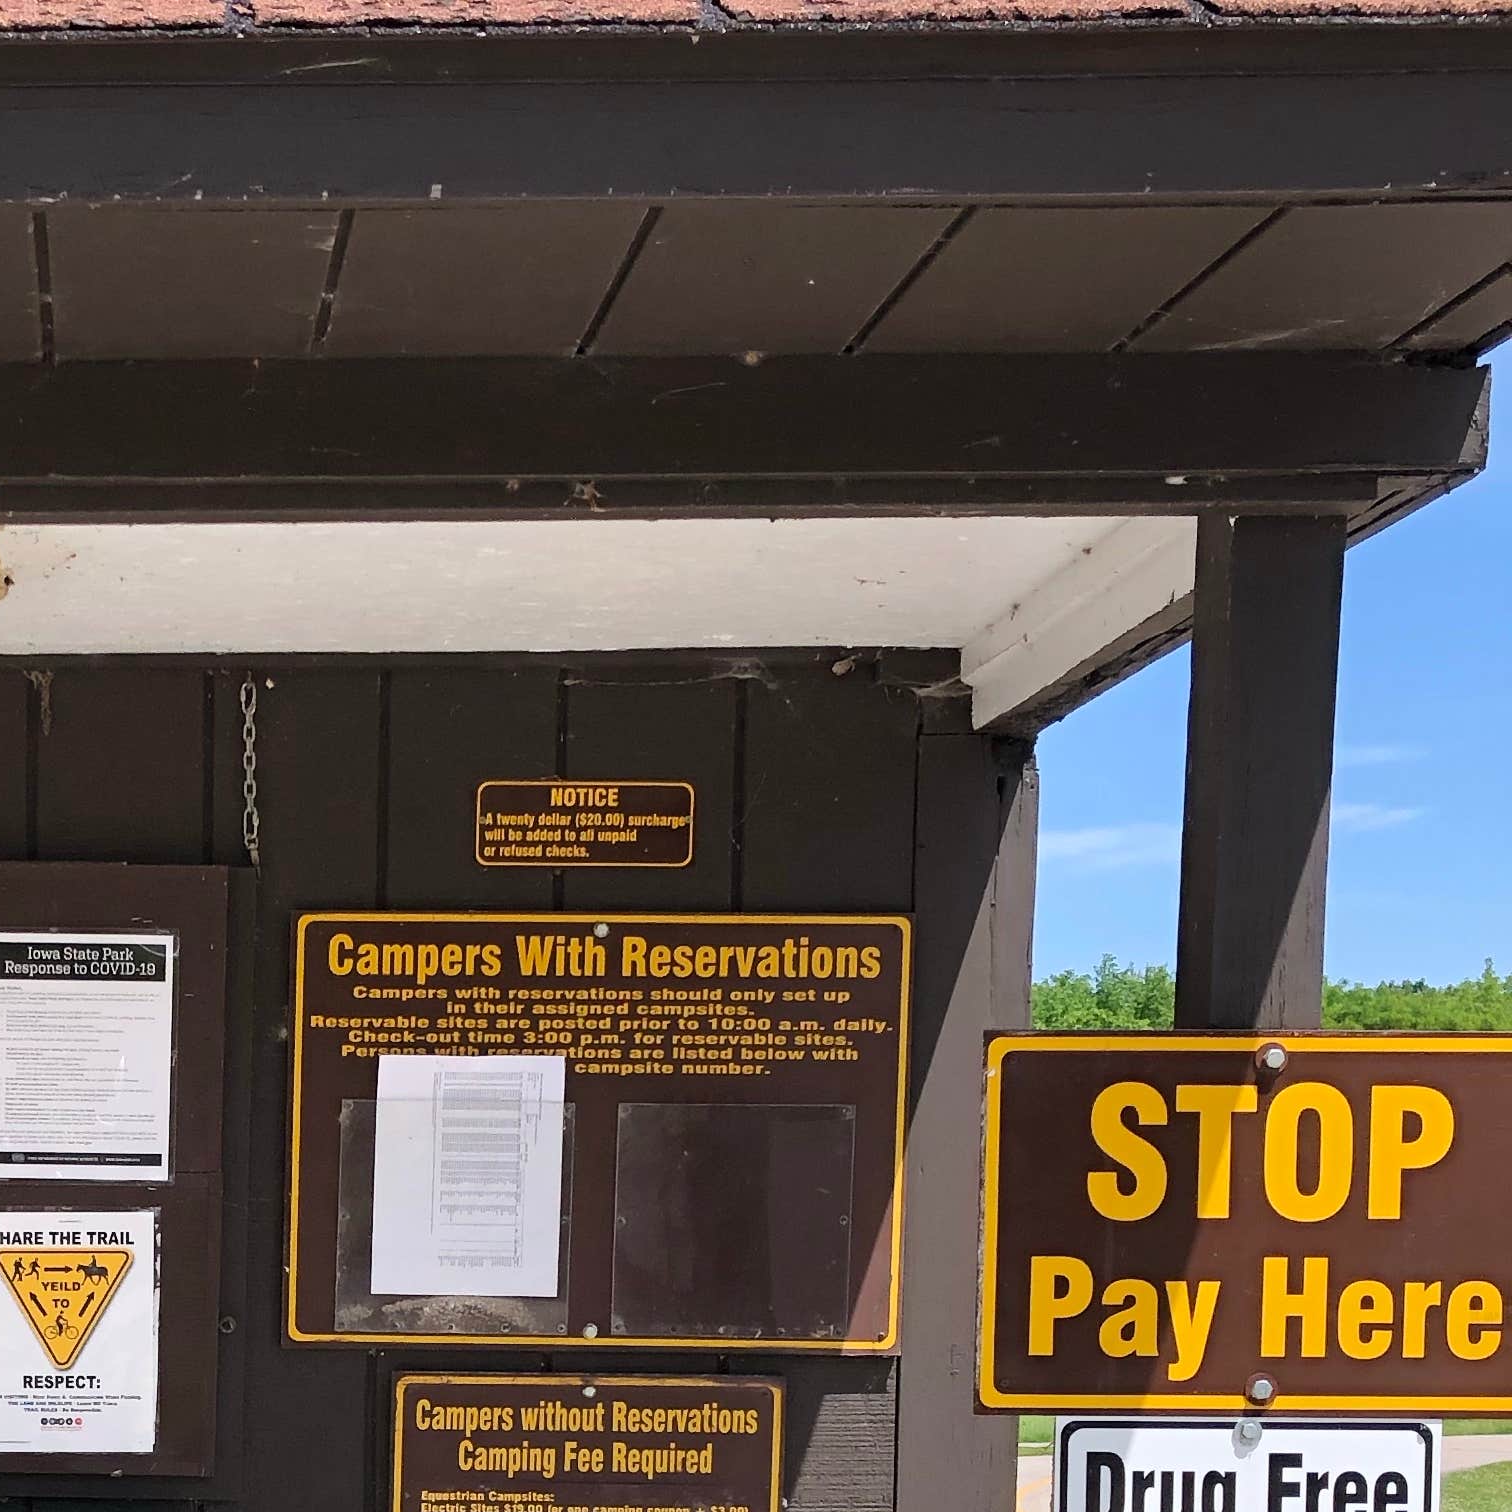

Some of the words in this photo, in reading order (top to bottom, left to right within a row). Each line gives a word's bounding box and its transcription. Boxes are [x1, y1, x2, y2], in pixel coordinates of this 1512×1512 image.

[550, 787, 618, 806] NOTICE
[484, 813, 493, 825] A
[496, 812, 535, 828] twenty
[537, 813, 571, 826] dollar
[575, 813, 624, 828] ($20.00)
[627, 813, 685, 830] surcharge
[484, 829, 505, 841] will
[508, 829, 522, 841] be
[525, 829, 561, 841] added
[564, 829, 576, 841] to
[579, 829, 594, 841] all
[597, 829, 637, 844] unpaid
[483, 846, 496, 856] or
[499, 844, 542, 857] refused
[545, 844, 589, 857] checks.
[27, 946, 60, 960] Iowa
[63, 946, 99, 960] State
[102, 947, 133, 962] Park
[328, 933, 501, 985] Campers
[515, 936, 606, 976] With
[621, 935, 880, 978] Reservations
[4, 960, 71, 976] Response
[73, 962, 87, 974] to
[90, 961, 155, 975] COVID-19
[353, 986, 447, 1001] Campers
[454, 986, 500, 999] with
[508, 986, 643, 1000] reservations
[650, 988, 722, 1000] should
[729, 988, 775, 1003] only
[782, 989, 816, 1001] set
[823, 991, 850, 1003] up
[446, 1001, 466, 1013] in
[473, 1001, 524, 1014] their
[532, 1002, 628, 1017] assigned
[636, 1002, 754, 1018] campsites.
[310, 1015, 429, 1031] Reservable
[436, 1016, 488, 1028] sites
[495, 1018, 530, 1028] are
[538, 1016, 611, 1031] posted
[619, 1017, 671, 1032] prior
[677, 1018, 699, 1030] to
[708, 1017, 770, 1030] 10:00
[778, 1020, 825, 1034] a.m.
[833, 1018, 892, 1033] daily.
[1086, 1081, 1455, 1223] STOP
[48, 1231, 81, 1245] THE
[86, 1231, 134, 1245] TRAIL
[41, 1281, 81, 1292] YEILD
[52, 1298, 70, 1308] TO
[1028, 1256, 1221, 1382] Pay
[1260, 1257, 1502, 1360] Here
[23, 1375, 100, 1388] RESPECT:
[416, 1398, 513, 1437] Campers
[520, 1400, 604, 1431] without
[612, 1401, 758, 1434] Reservations
[458, 1439, 555, 1478] Camping
[563, 1441, 603, 1472] Fee
[612, 1441, 712, 1480] Required
